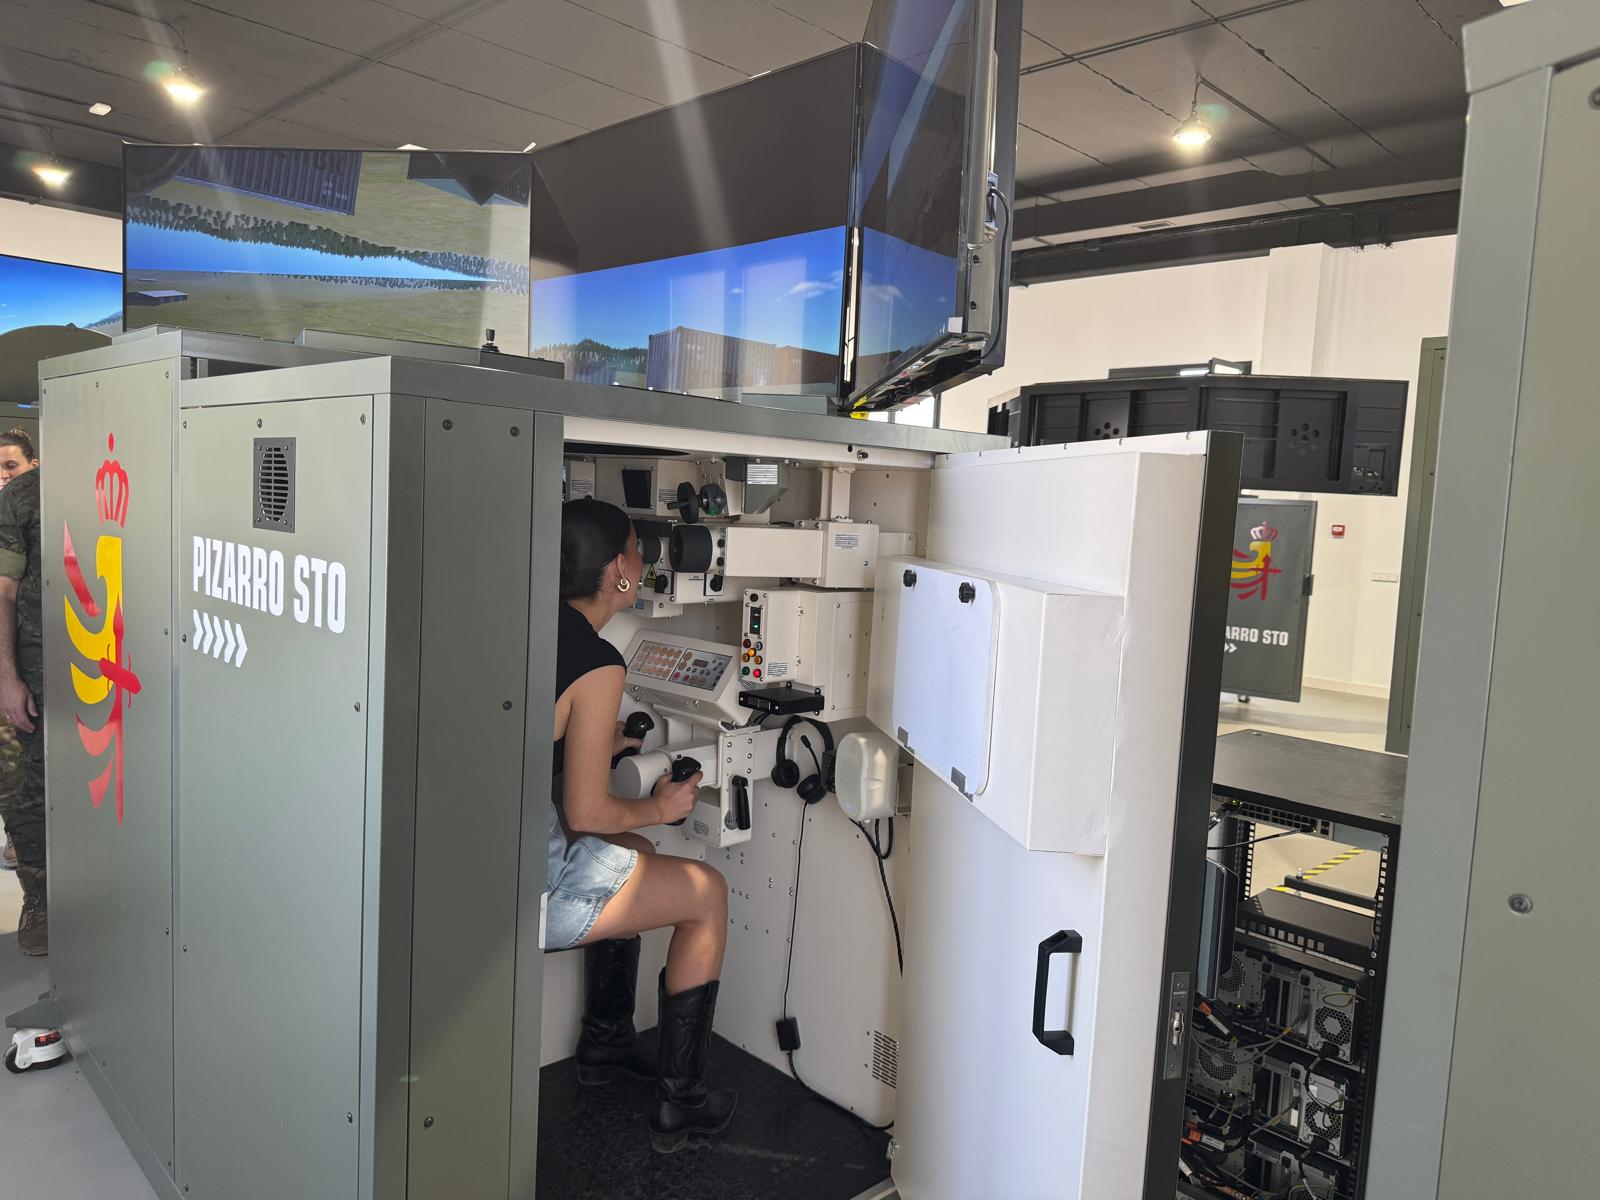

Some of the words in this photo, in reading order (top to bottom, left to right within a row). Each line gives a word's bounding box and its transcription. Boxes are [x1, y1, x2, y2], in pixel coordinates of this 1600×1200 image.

[193, 535, 284, 616] PIZARRO
[293, 554, 346, 633] STO
[1225, 625, 1259, 643] ARRO
[1262, 629, 1289, 646] STO
